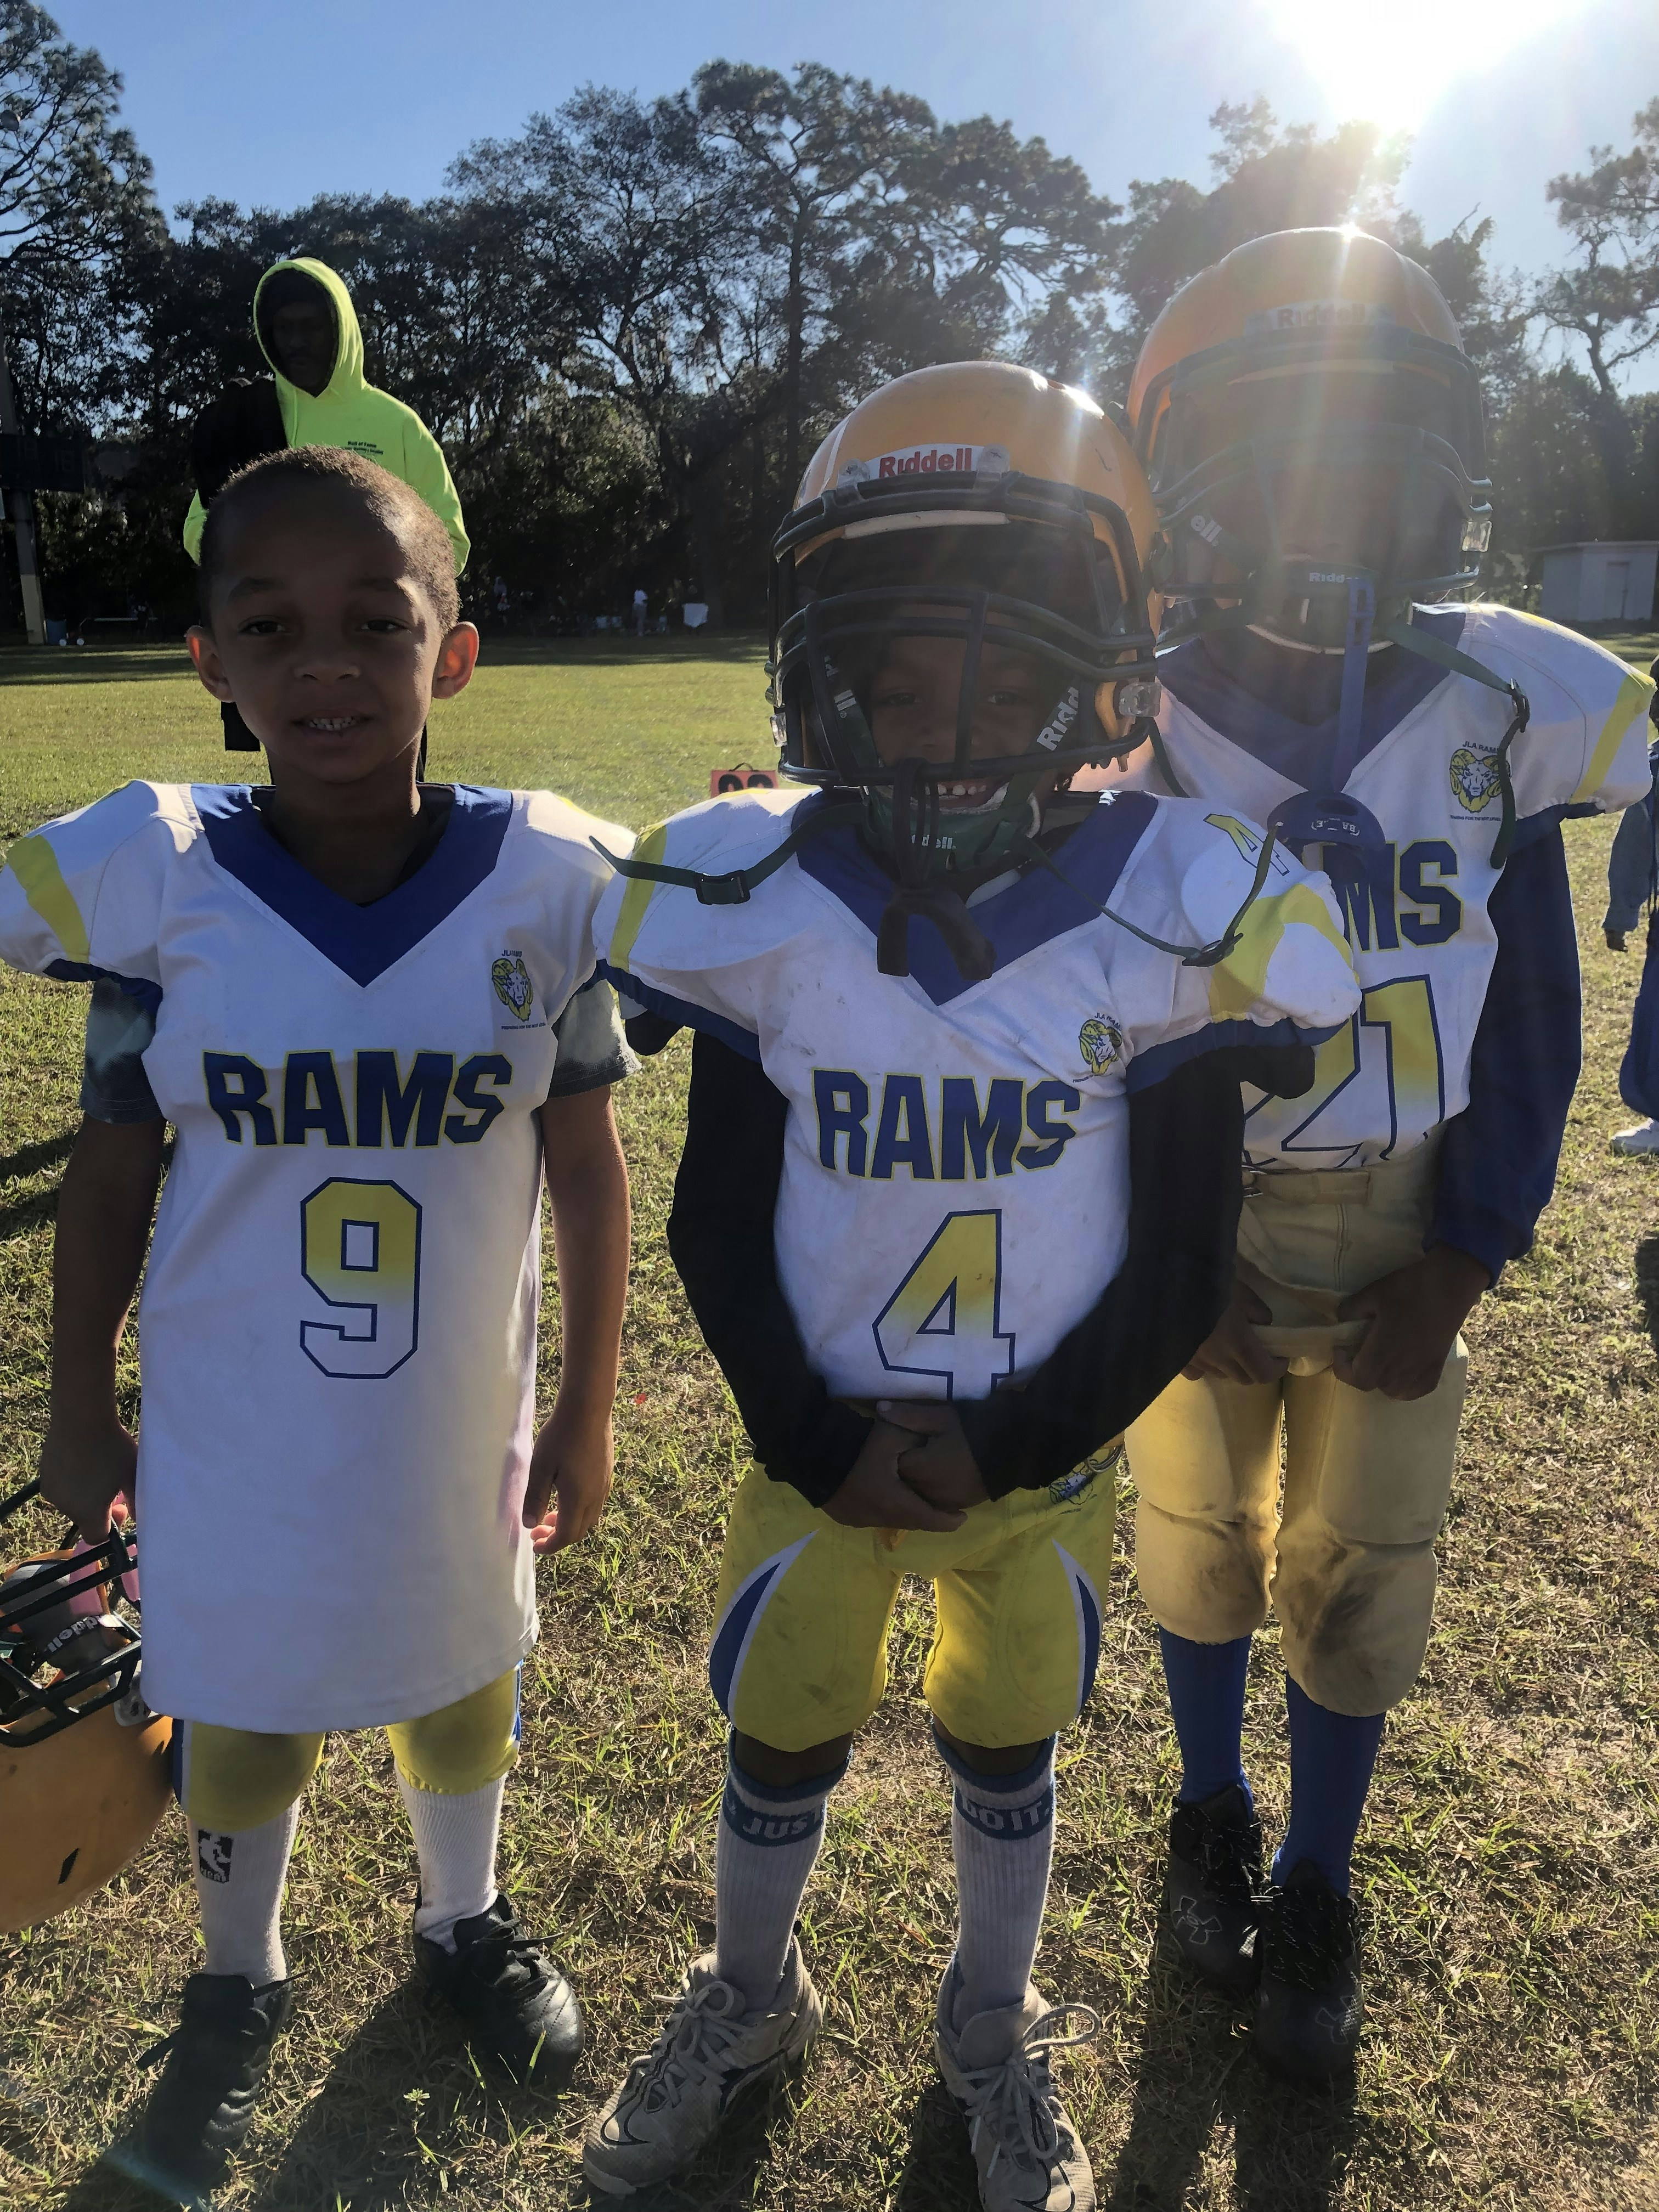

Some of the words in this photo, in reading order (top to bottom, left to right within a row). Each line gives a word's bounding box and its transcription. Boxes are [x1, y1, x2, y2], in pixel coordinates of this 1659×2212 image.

[879, 448, 972, 479] Riddell
[1309, 572, 1359, 583] Ridd
[1036, 687, 1079, 751] Ridd
[1203, 813, 1290, 877] 4
[1319, 839, 1464, 953] MS
[201, 1049, 514, 1149] RAMS
[811, 1066, 1082, 1183] RAMS
[300, 1176, 423, 1379] 9
[871, 1209, 1016, 1402] 4
